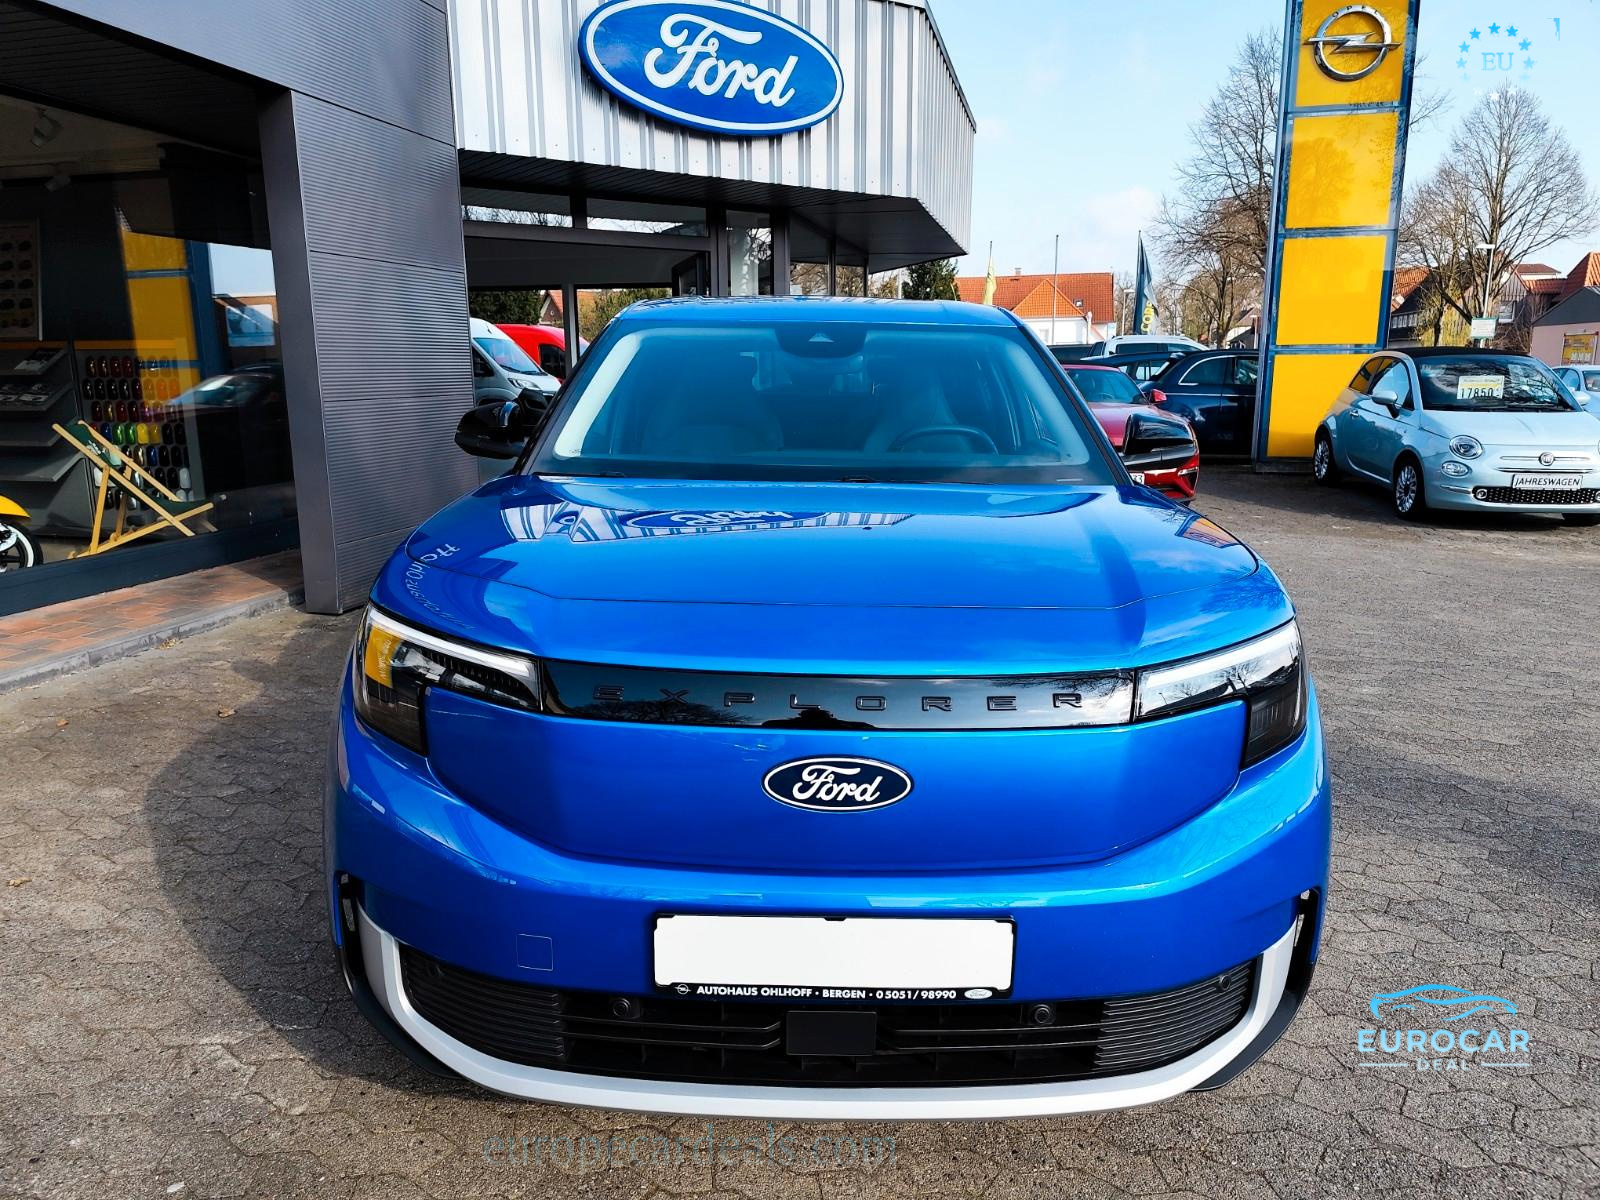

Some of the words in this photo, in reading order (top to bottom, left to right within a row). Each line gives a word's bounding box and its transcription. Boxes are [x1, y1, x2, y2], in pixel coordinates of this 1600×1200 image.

[644, 13, 799, 107] Ford
[1515, 477, 1581, 487] JAHRESWAGEN
[594, 684, 1083, 712] EXPLORER
[792, 764, 883, 802] Ford
[696, 985, 758, 996] AUTOHAUS
[760, 986, 812, 997] OHLHOFF
[822, 988, 866, 999] BERGEN
